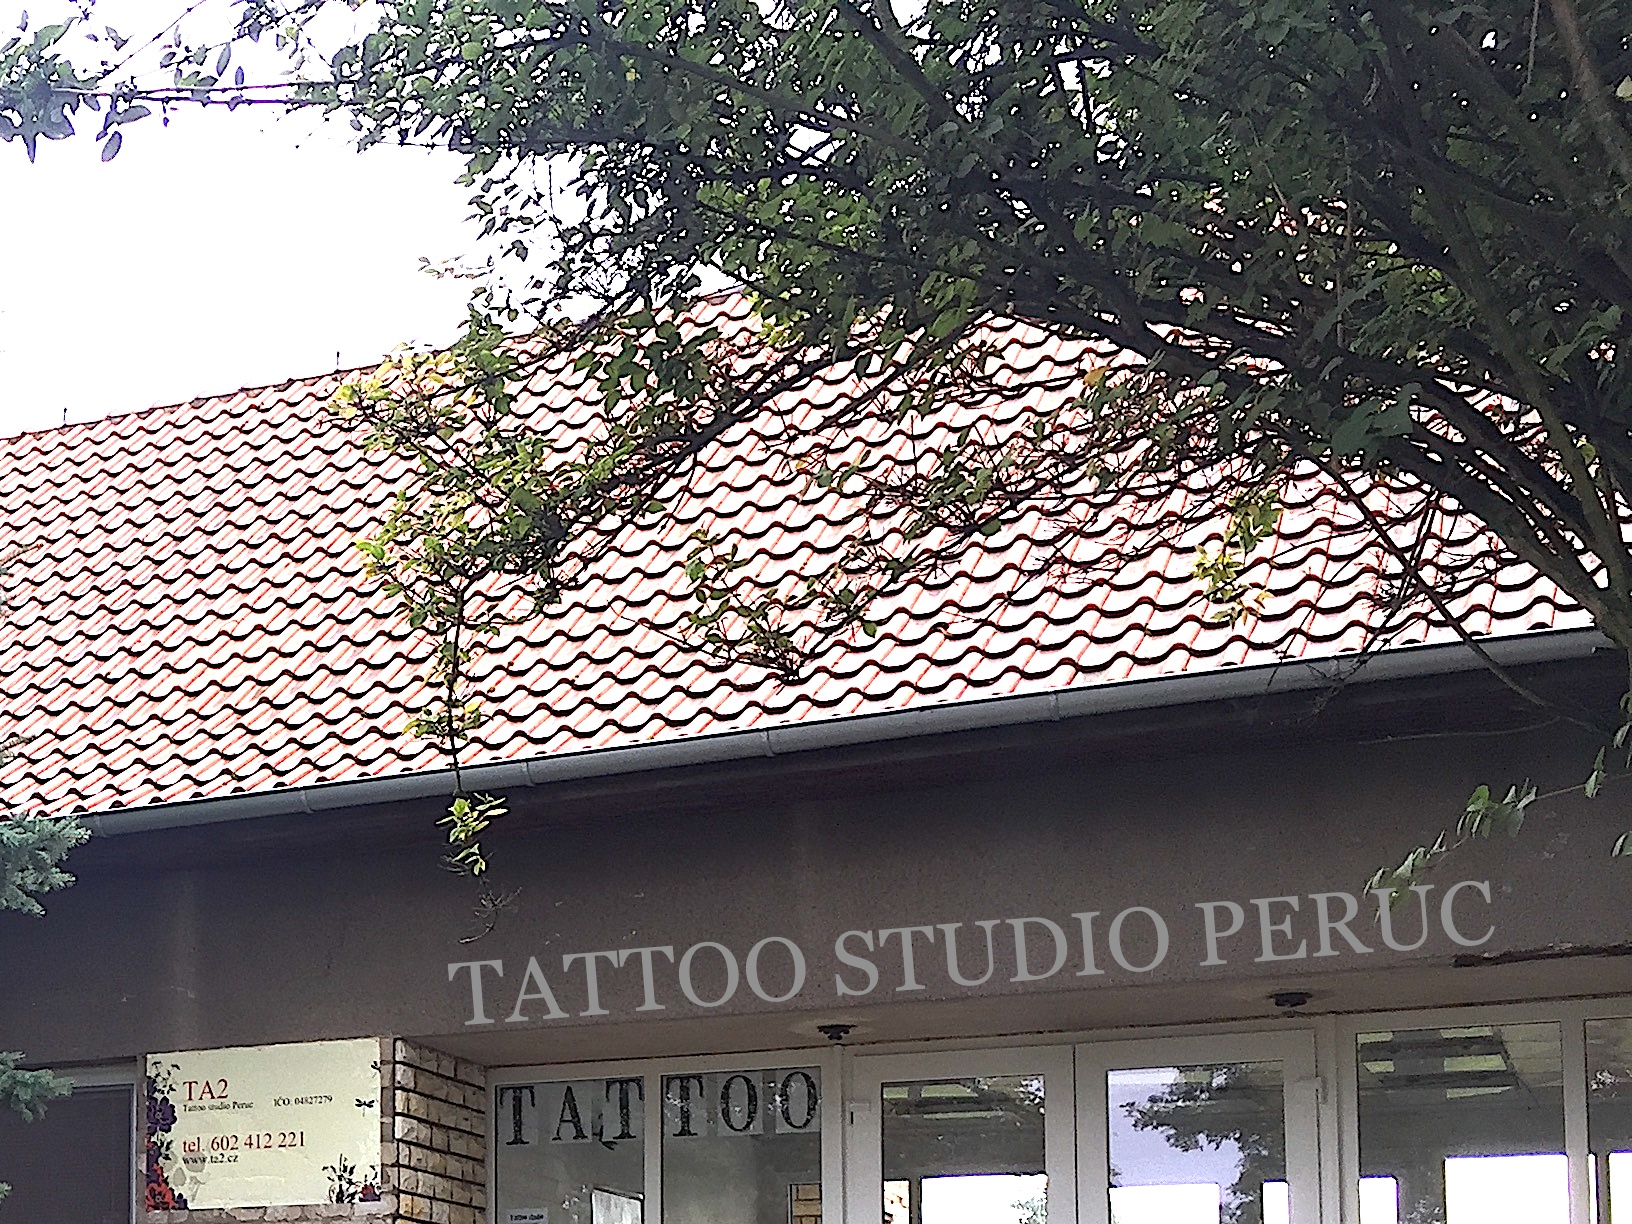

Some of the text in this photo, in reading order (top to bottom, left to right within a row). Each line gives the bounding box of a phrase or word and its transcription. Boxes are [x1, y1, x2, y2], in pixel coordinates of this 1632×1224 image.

[182, 1078, 229, 1101] TA2
[182, 1131, 305, 1153] tel. 602 412 221
[181, 1153, 239, 1165] www.ta2.cz
